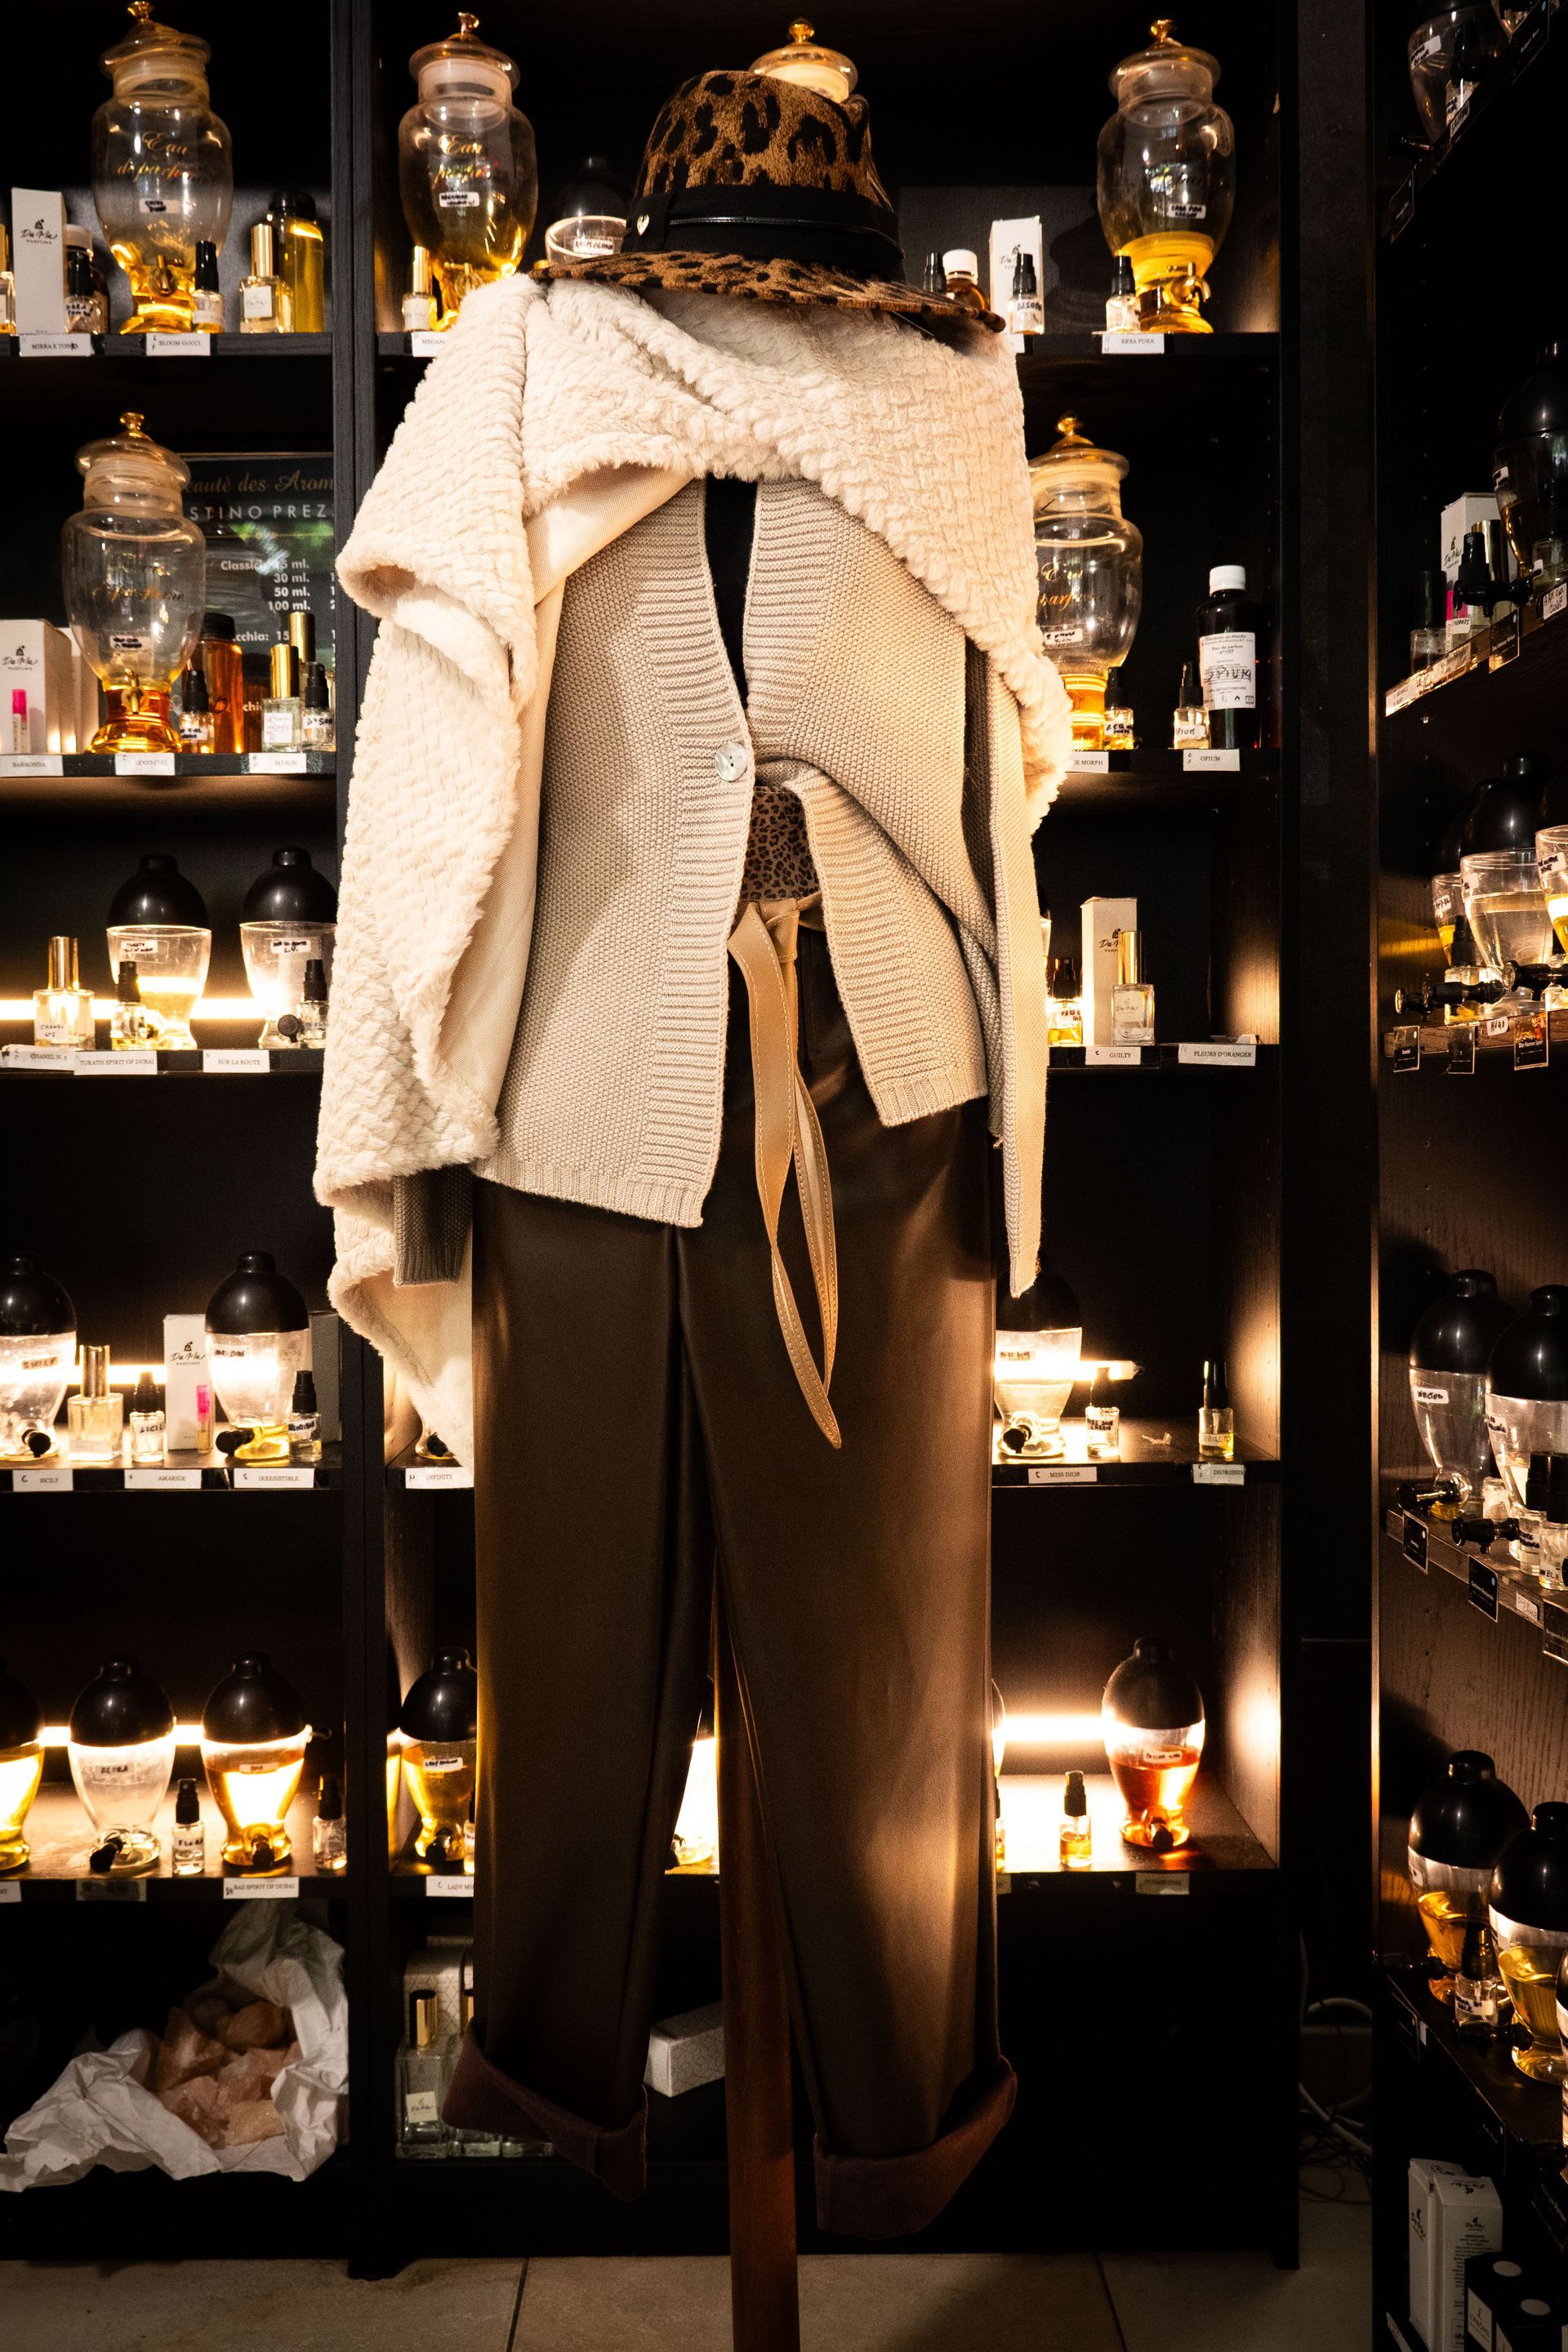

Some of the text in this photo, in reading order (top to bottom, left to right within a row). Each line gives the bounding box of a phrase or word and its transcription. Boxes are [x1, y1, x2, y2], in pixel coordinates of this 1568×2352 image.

[142, 131, 188, 154] Eau
[438, 134, 483, 155] Eau
[238, 474, 268, 492] des
[292, 559, 310, 569] ml.
[274, 573, 289, 583] 30
[292, 572, 310, 583] ml.
[274, 587, 289, 598] 50
[292, 586, 311, 597] ml.
[268, 601, 289, 612] 100
[292, 600, 311, 611] ml.
[277, 630, 290, 641] 15
[79, 1058, 105, 1067] TURATH
[135, 1058, 154, 1066] DUBAI
[426, 1473, 453, 1481] INFINITY
